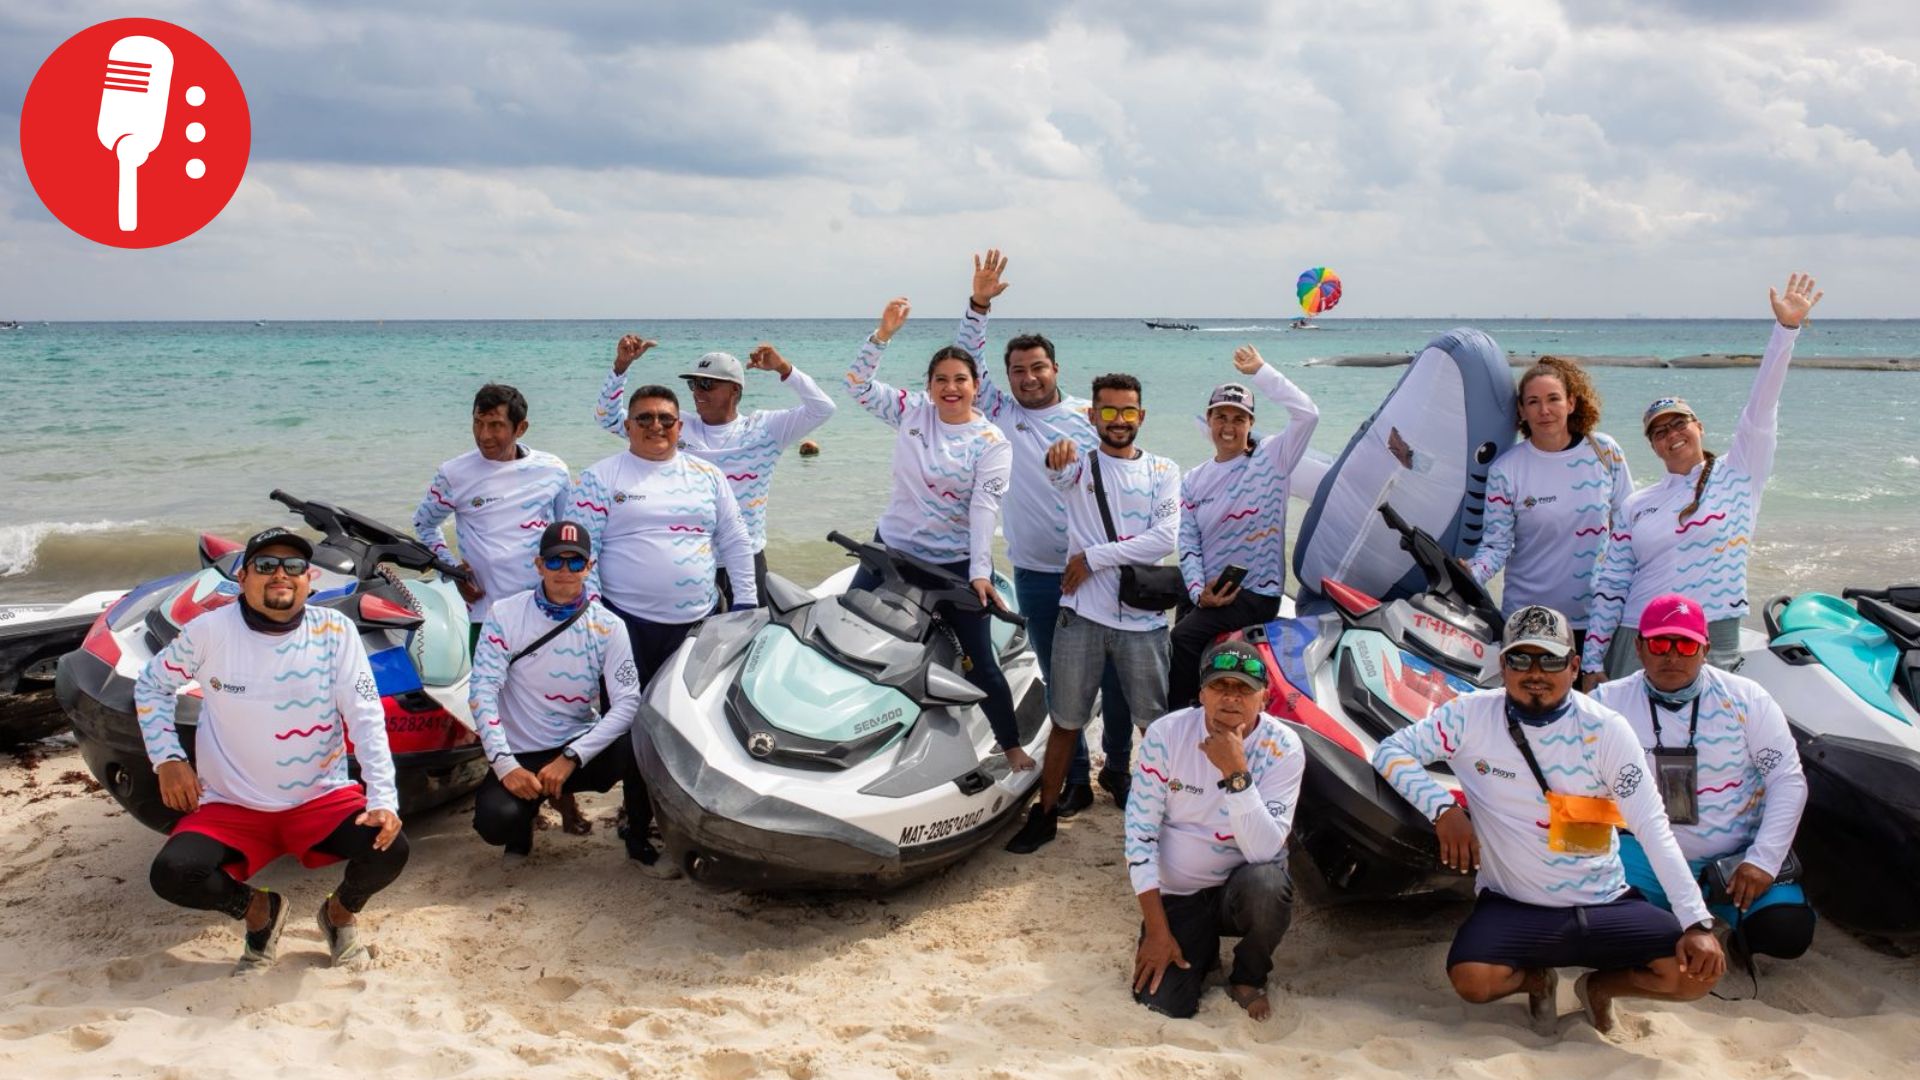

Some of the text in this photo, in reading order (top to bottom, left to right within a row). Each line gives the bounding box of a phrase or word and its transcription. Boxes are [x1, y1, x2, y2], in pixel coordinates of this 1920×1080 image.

[223, 683, 246, 694] Playa
[1492, 767, 1516, 779] Playa
[1185, 784, 1204, 795] Playa
